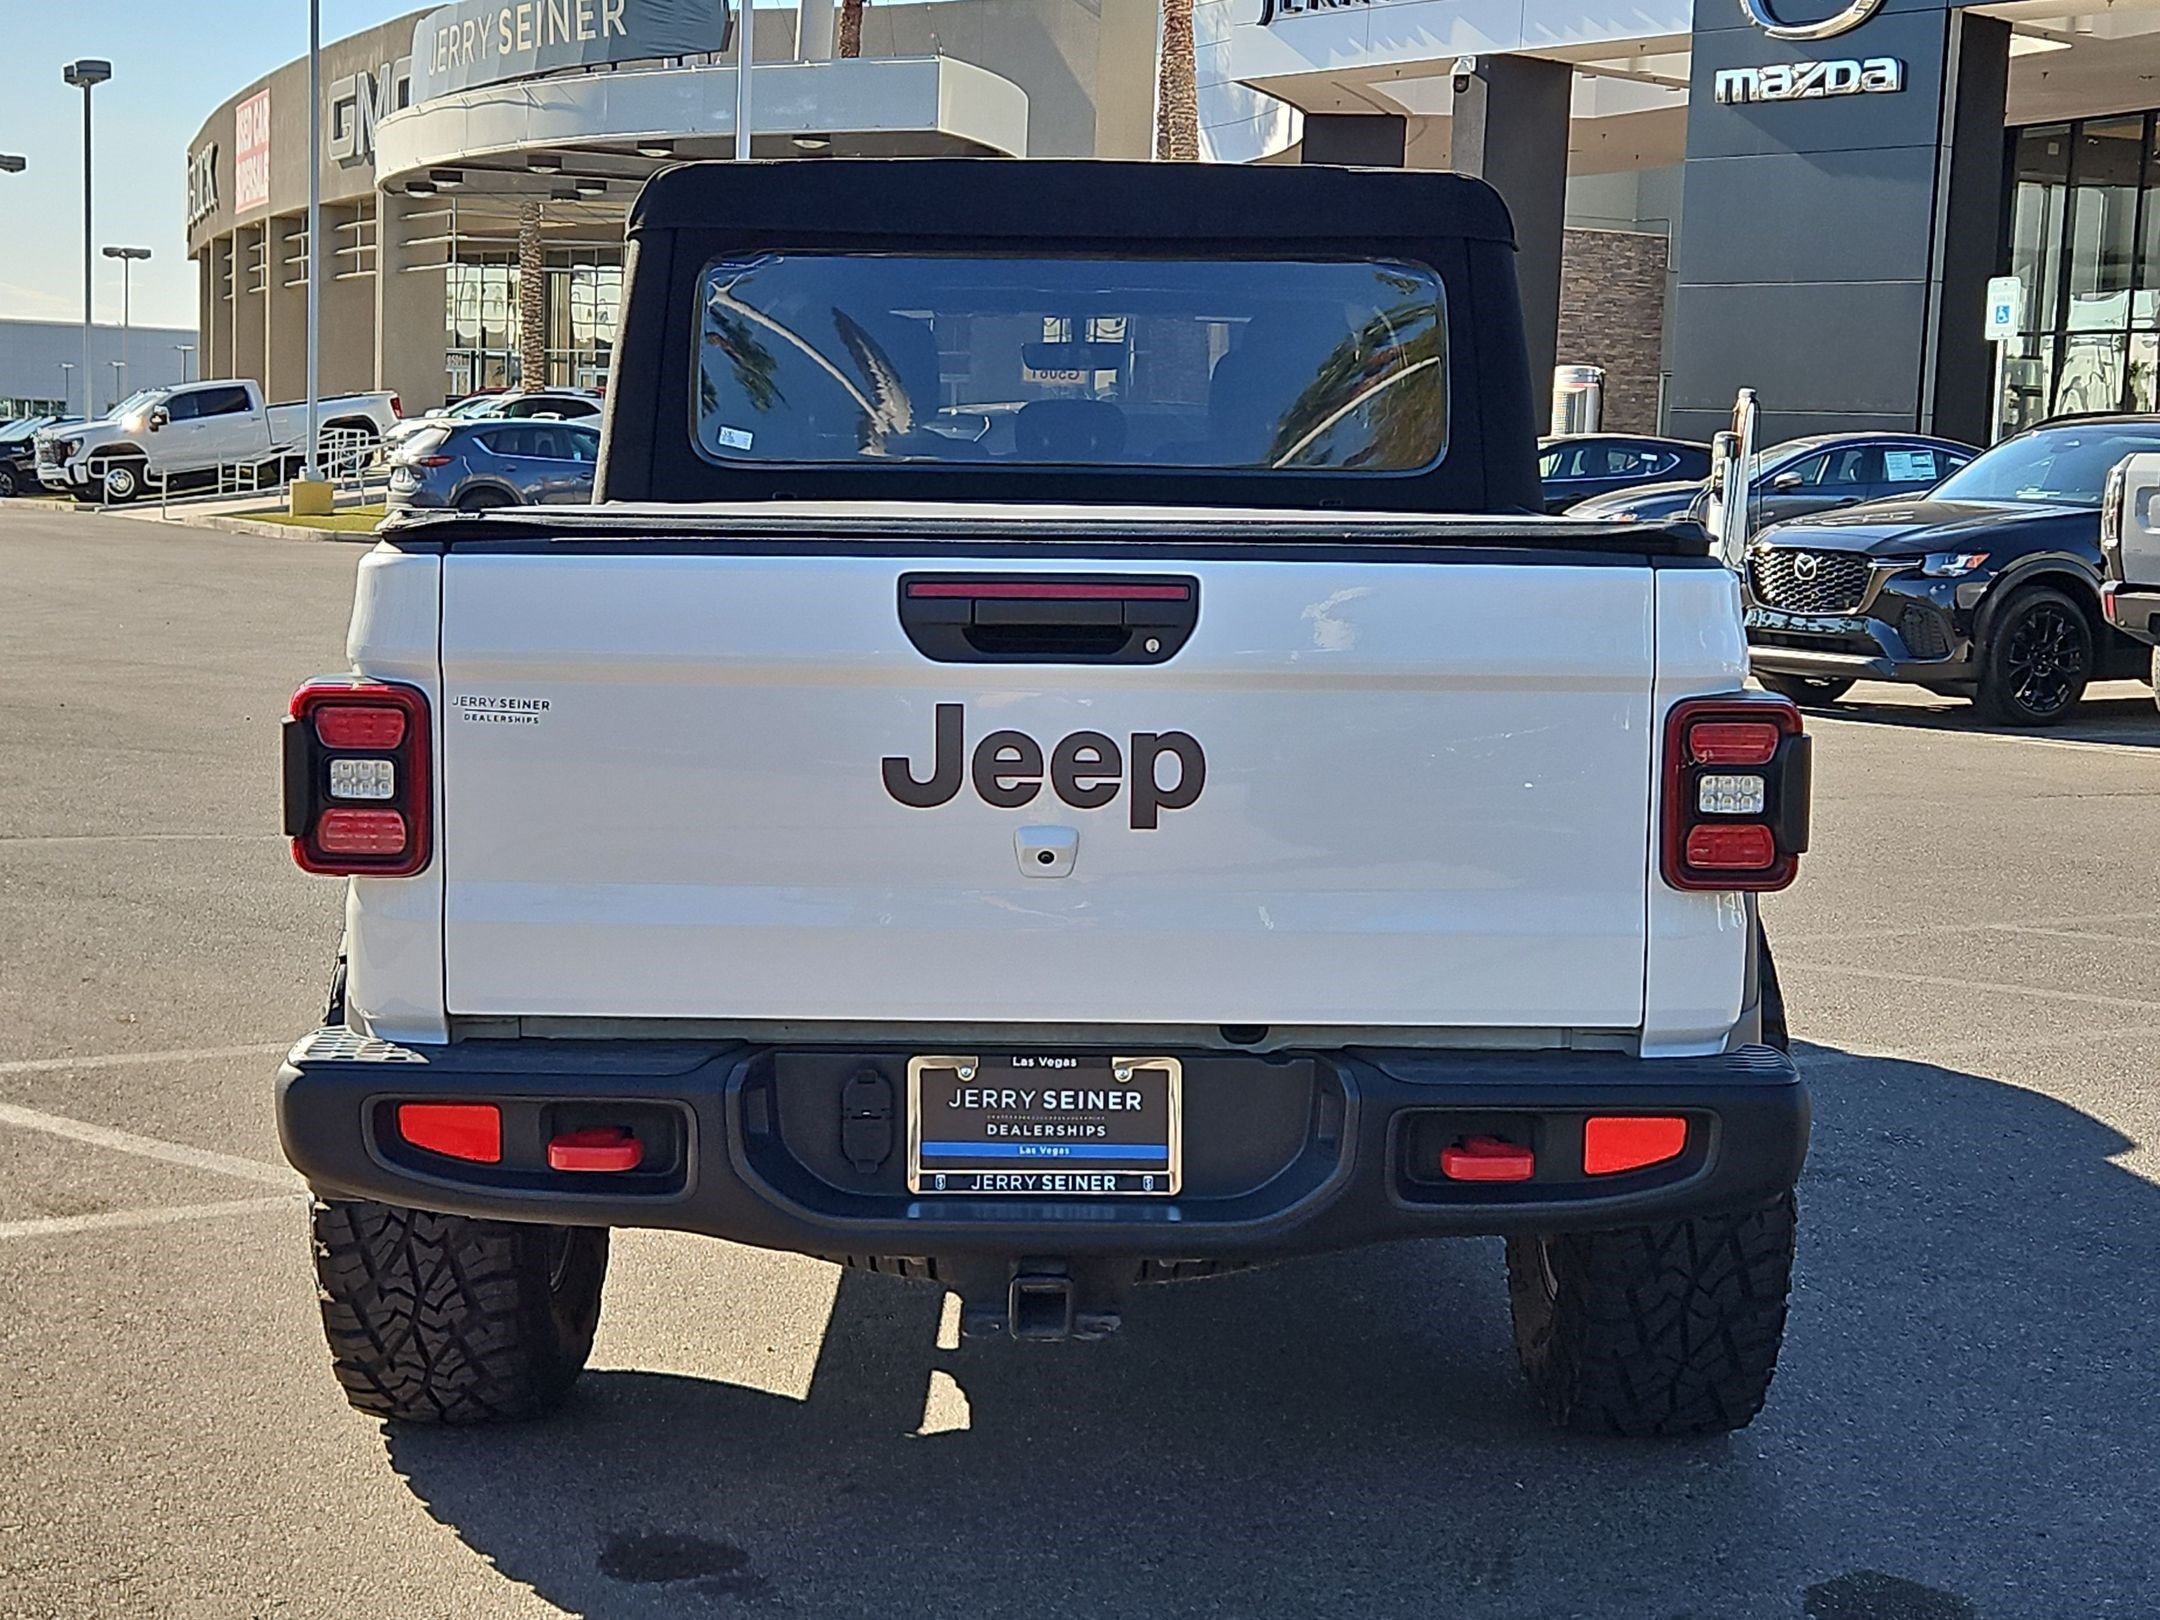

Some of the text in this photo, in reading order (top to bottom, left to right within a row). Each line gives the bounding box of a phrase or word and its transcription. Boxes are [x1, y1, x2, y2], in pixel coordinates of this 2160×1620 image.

[428, 0, 627, 76] JERRY SEINER
[452, 695, 550, 711] JERRY SEINER
[463, 713, 539, 725] DEALERSHIPS
[882, 703, 1206, 829] Jeep
[1012, 1056, 1077, 1069] Las Vegas
[949, 1088, 1142, 1111] JERRY SEINER
[986, 1123, 1106, 1137] DEALERSHIPS
[1018, 1145, 1070, 1158] Las Vegas
[971, 1175, 1117, 1191] JERRY SEINER
